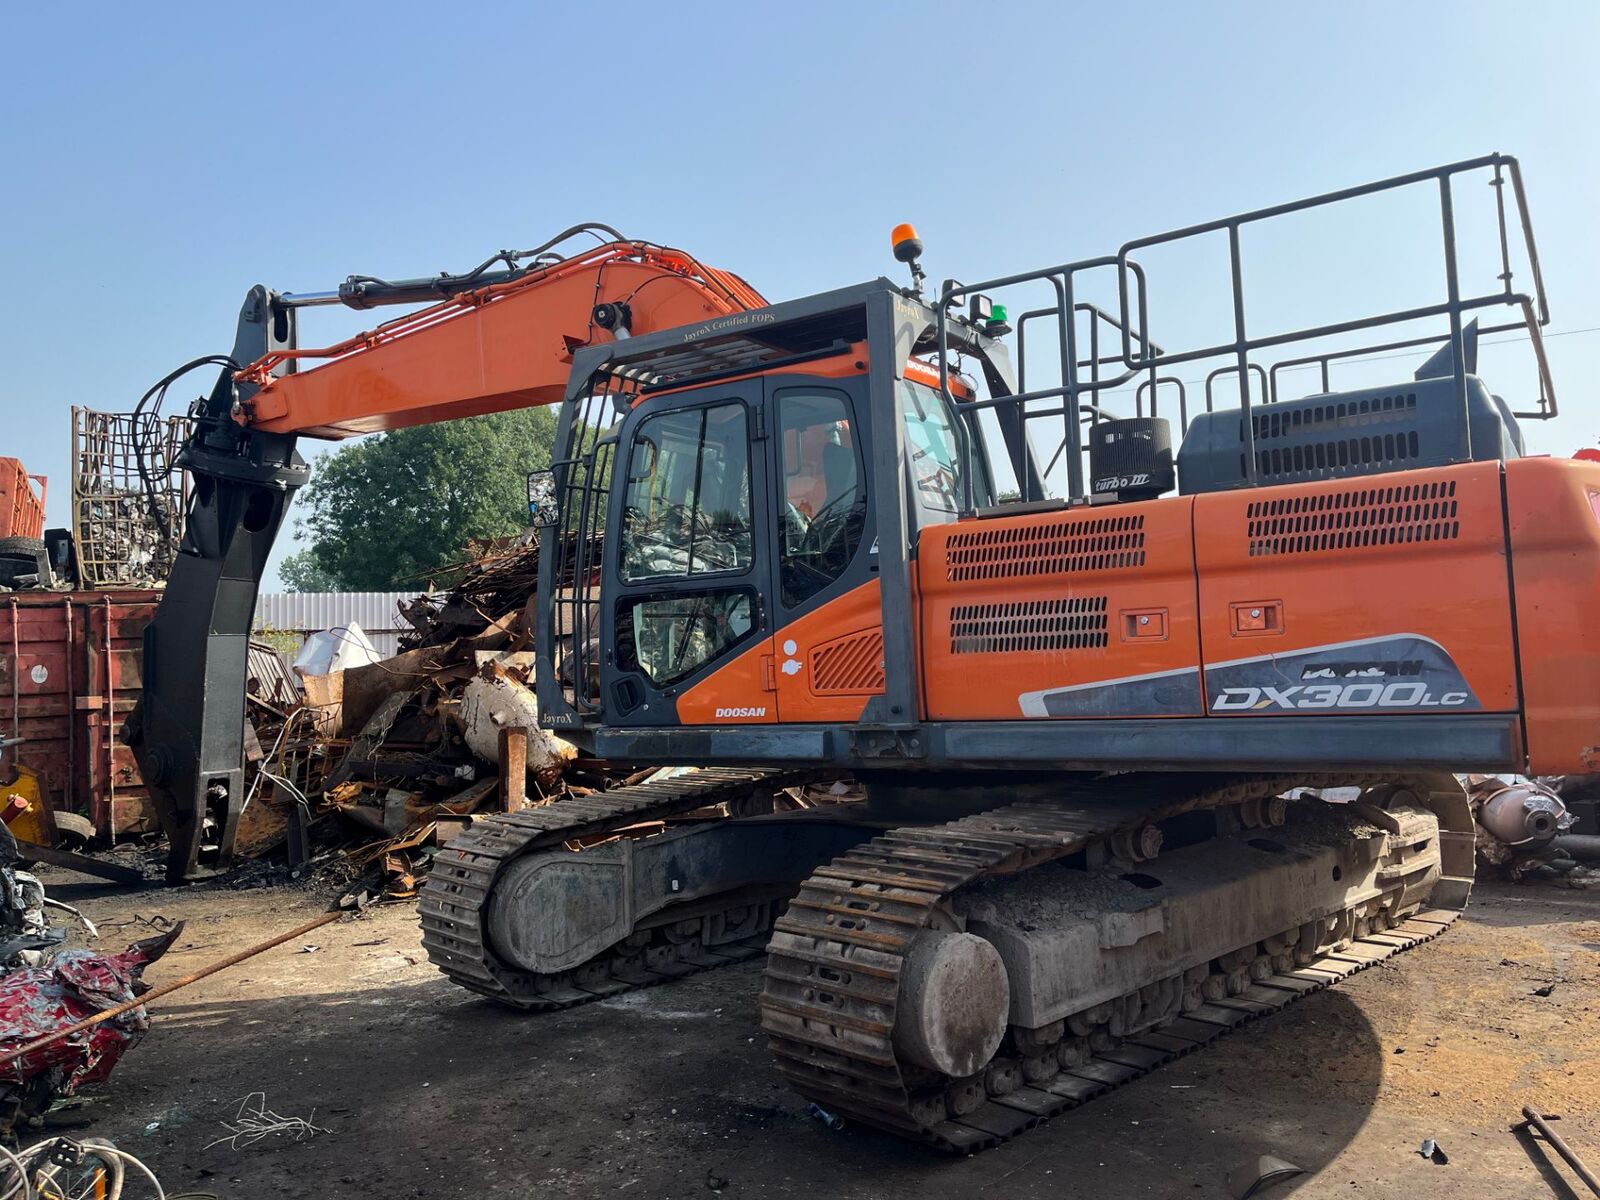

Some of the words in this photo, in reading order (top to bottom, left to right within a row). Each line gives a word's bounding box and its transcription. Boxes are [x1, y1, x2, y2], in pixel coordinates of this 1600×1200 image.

[683, 325, 711, 342] JayroX
[712, 315, 749, 330] Certified
[751, 313, 777, 324] FOPS
[542, 712, 573, 725] JayroX
[716, 707, 766, 718] DOOSAN
